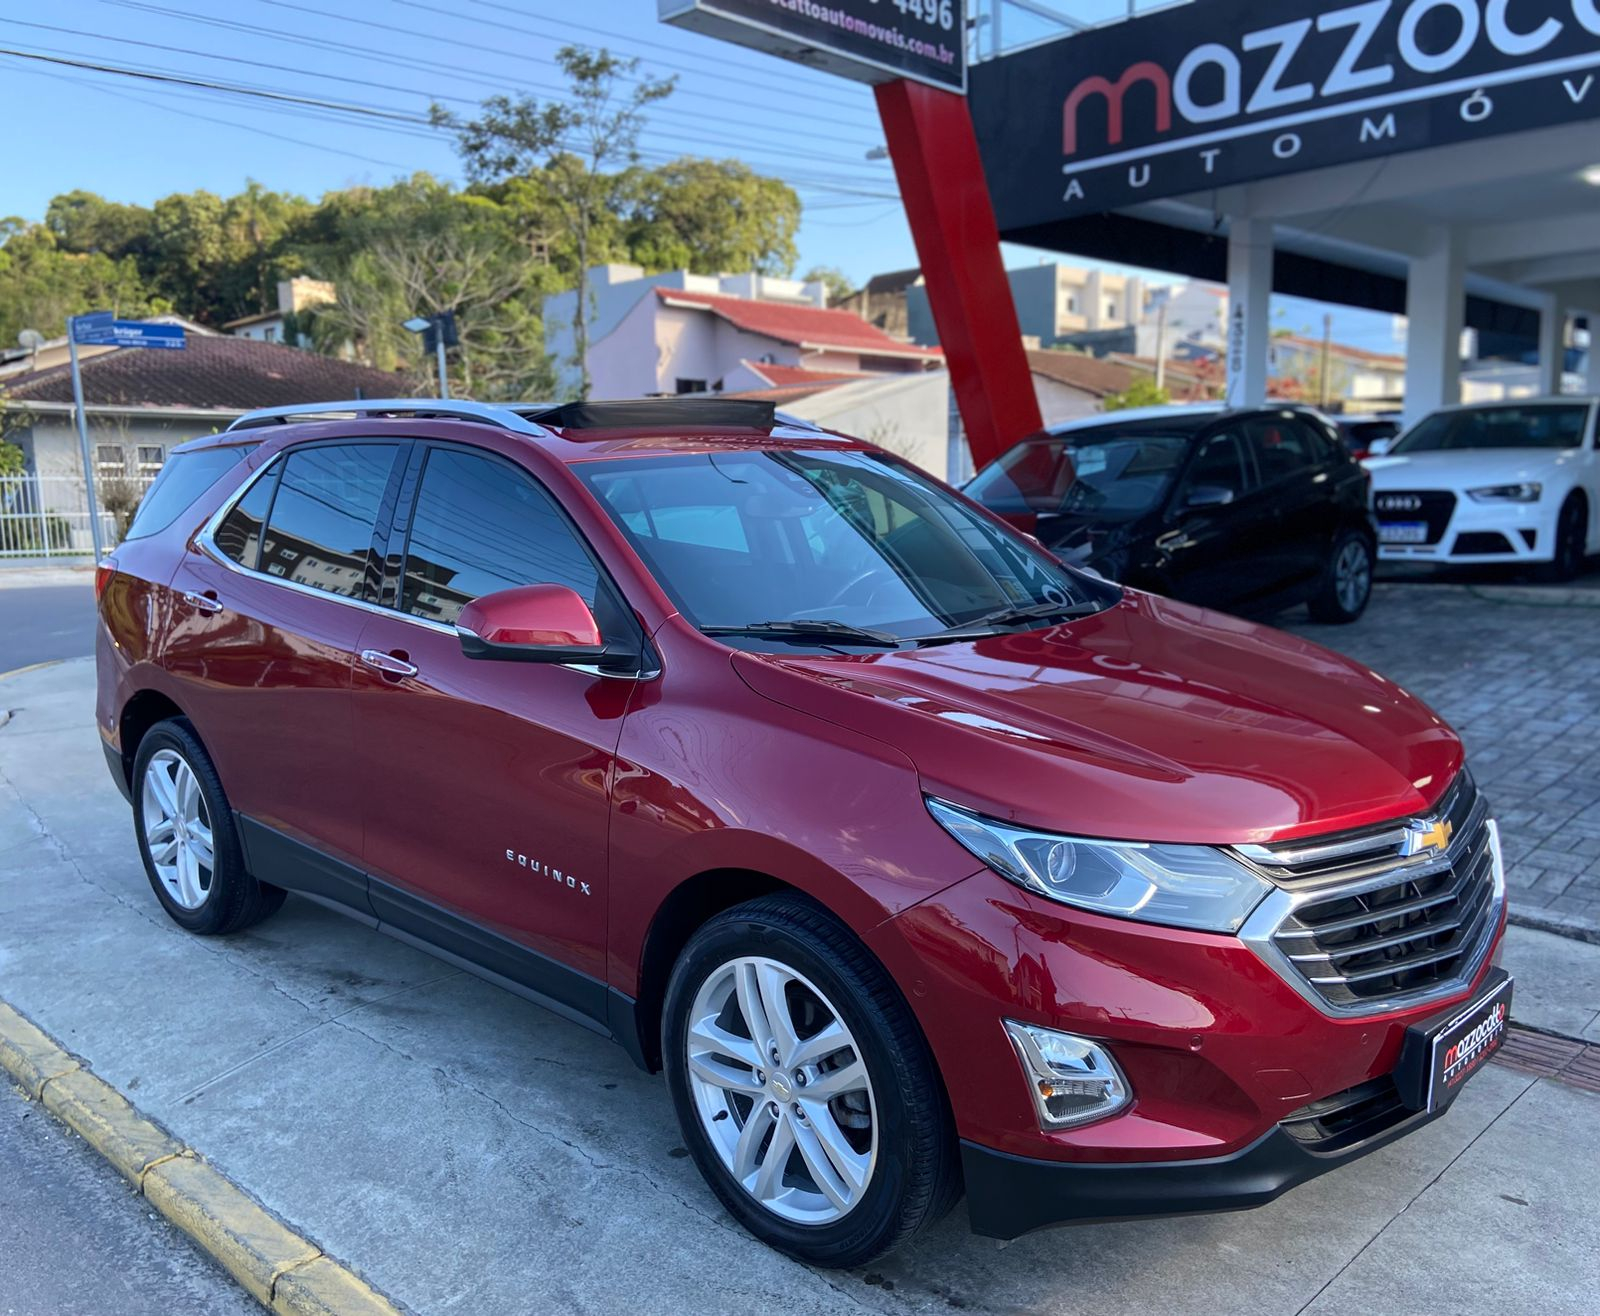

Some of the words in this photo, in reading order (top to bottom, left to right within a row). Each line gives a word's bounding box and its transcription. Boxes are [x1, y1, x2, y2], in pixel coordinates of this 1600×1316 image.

[1062, 0, 1600, 156] mazzoc
[505, 849, 591, 896] EQUINOX
[1444, 1002, 1505, 1069] mazzocatto
